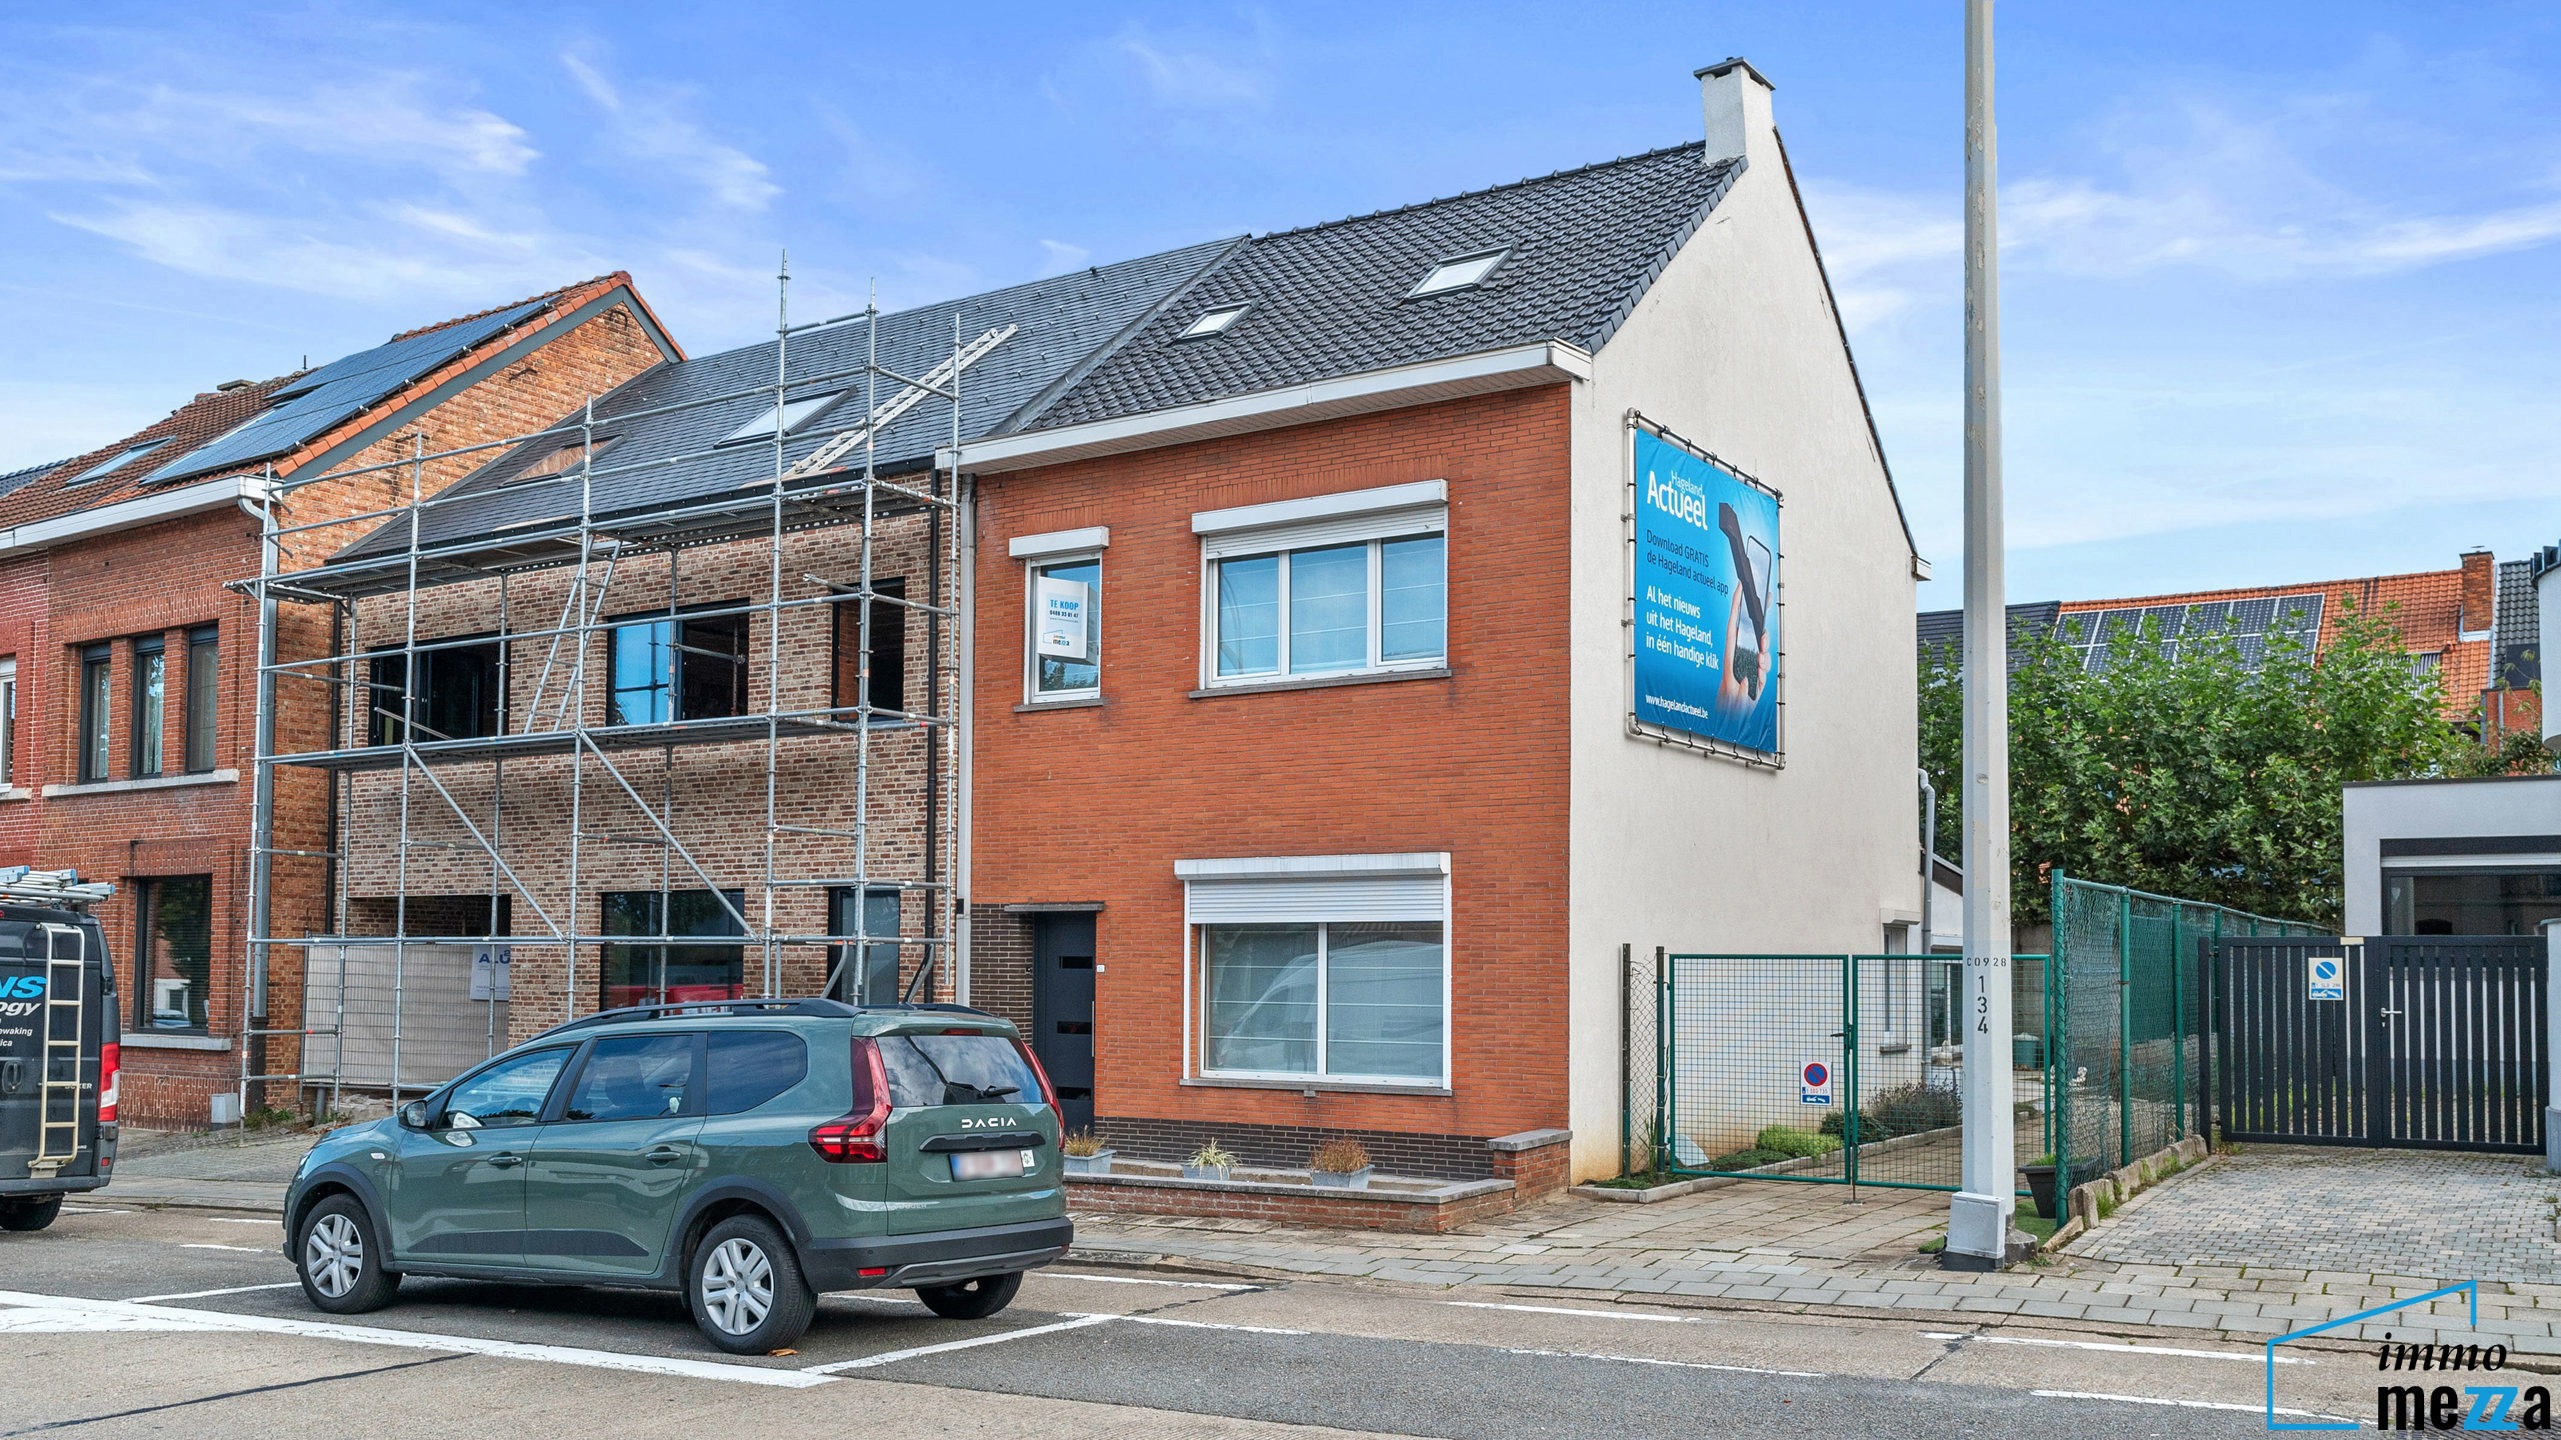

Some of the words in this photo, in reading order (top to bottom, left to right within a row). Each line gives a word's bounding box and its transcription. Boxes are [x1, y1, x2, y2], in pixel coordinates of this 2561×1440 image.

[1647, 470, 1708, 531] Actueel
[1671, 470, 1703, 497] Hageland
[1646, 529, 1683, 556] Download
[1685, 546, 1709, 568] GRATIS
[1647, 550, 1656, 564] de
[1658, 555, 1692, 579] Hageland
[1692, 570, 1716, 590] actueel
[1716, 580, 1728, 597] app
[1050, 600, 1057, 608] TE
[1060, 601, 1079, 610] KOOP
[1646, 585, 1656, 603] Al
[1658, 588, 1672, 609] het
[1673, 596, 1700, 619] nieuws
[1646, 609, 1658, 627] uit
[1660, 611, 1674, 632] het
[1675, 618, 1713, 648] Hageland,
[1646, 632, 1654, 649] in
[1656, 633, 1672, 655] één
[1674, 640, 1704, 668] handige
[1706, 651, 1719, 670] klik
[1645, 694, 1708, 720] www.hagelandactueel.be
[961, 1117, 1017, 1129] DACIA
